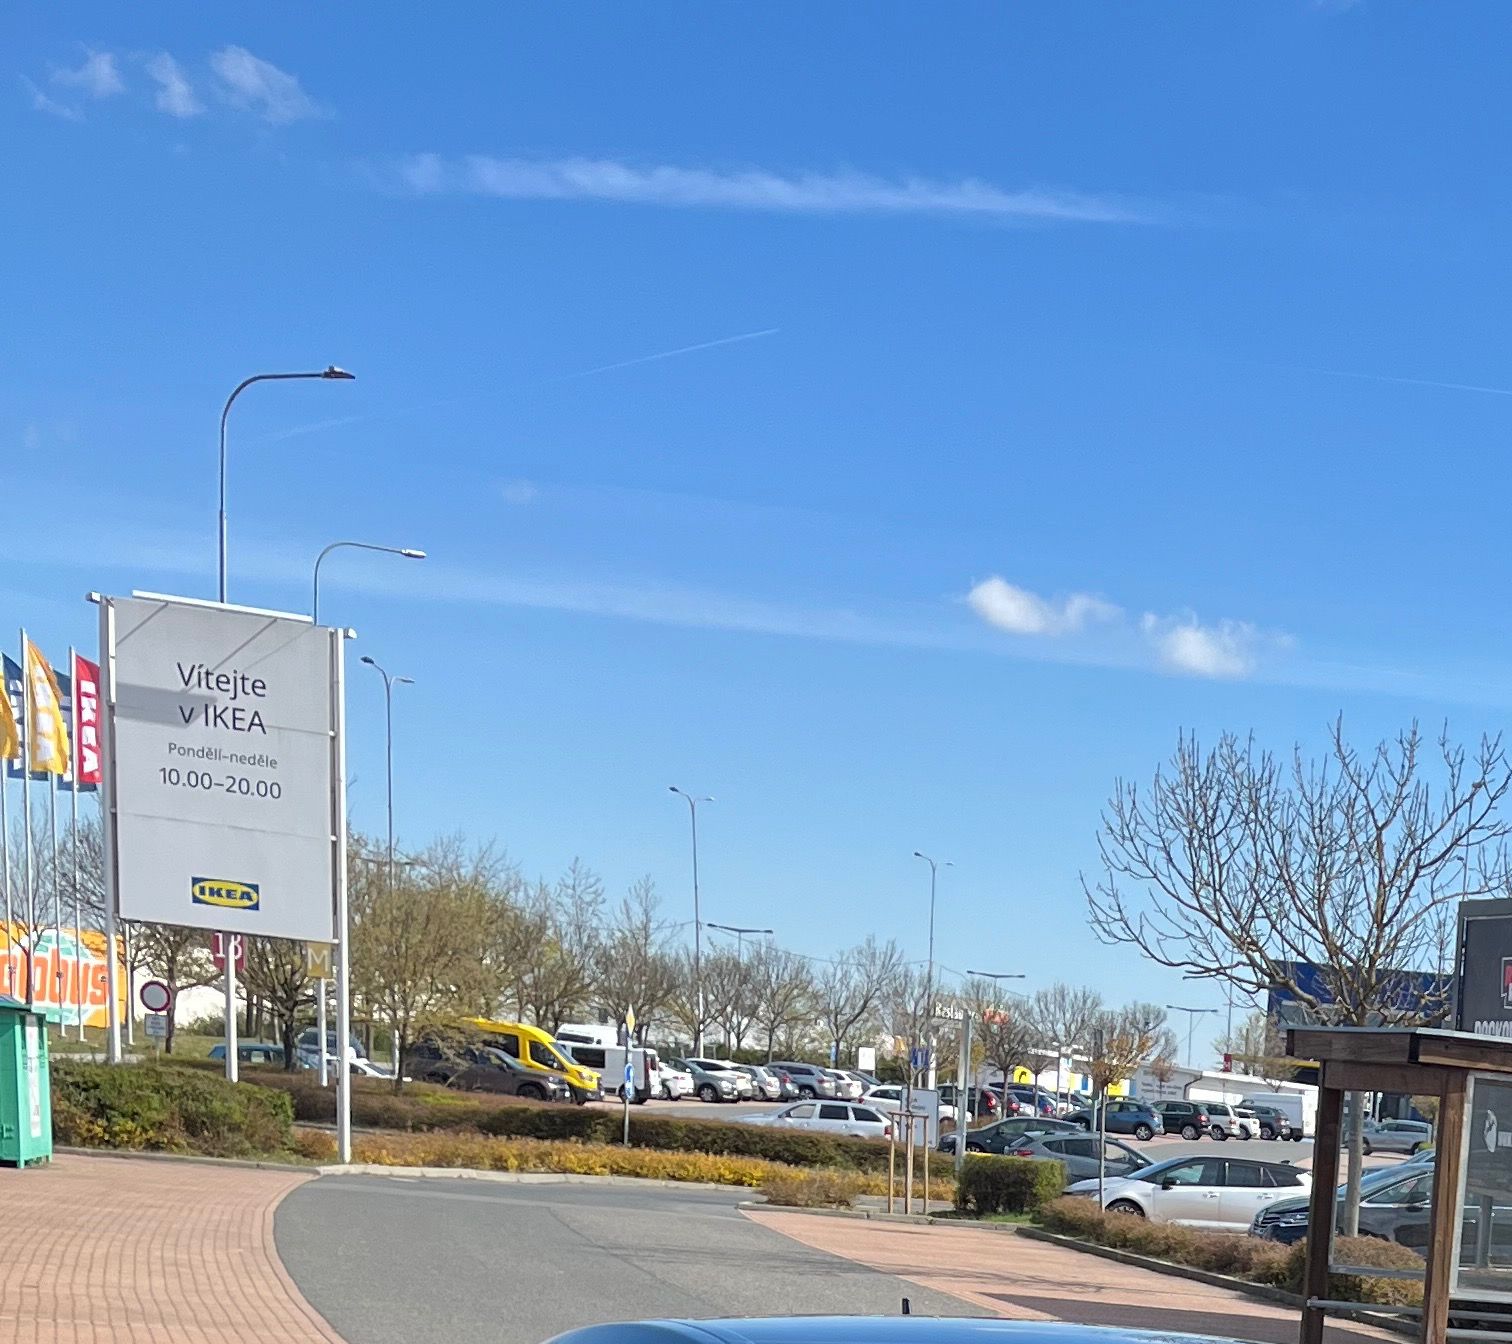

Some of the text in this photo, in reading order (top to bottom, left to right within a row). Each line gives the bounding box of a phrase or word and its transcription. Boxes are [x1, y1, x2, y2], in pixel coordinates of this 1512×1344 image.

[176, 661, 266, 700] Vítejte
[80, 680, 99, 774] IKEA
[178, 703, 267, 735] v IKEA
[198, 884, 253, 902] IKEA
